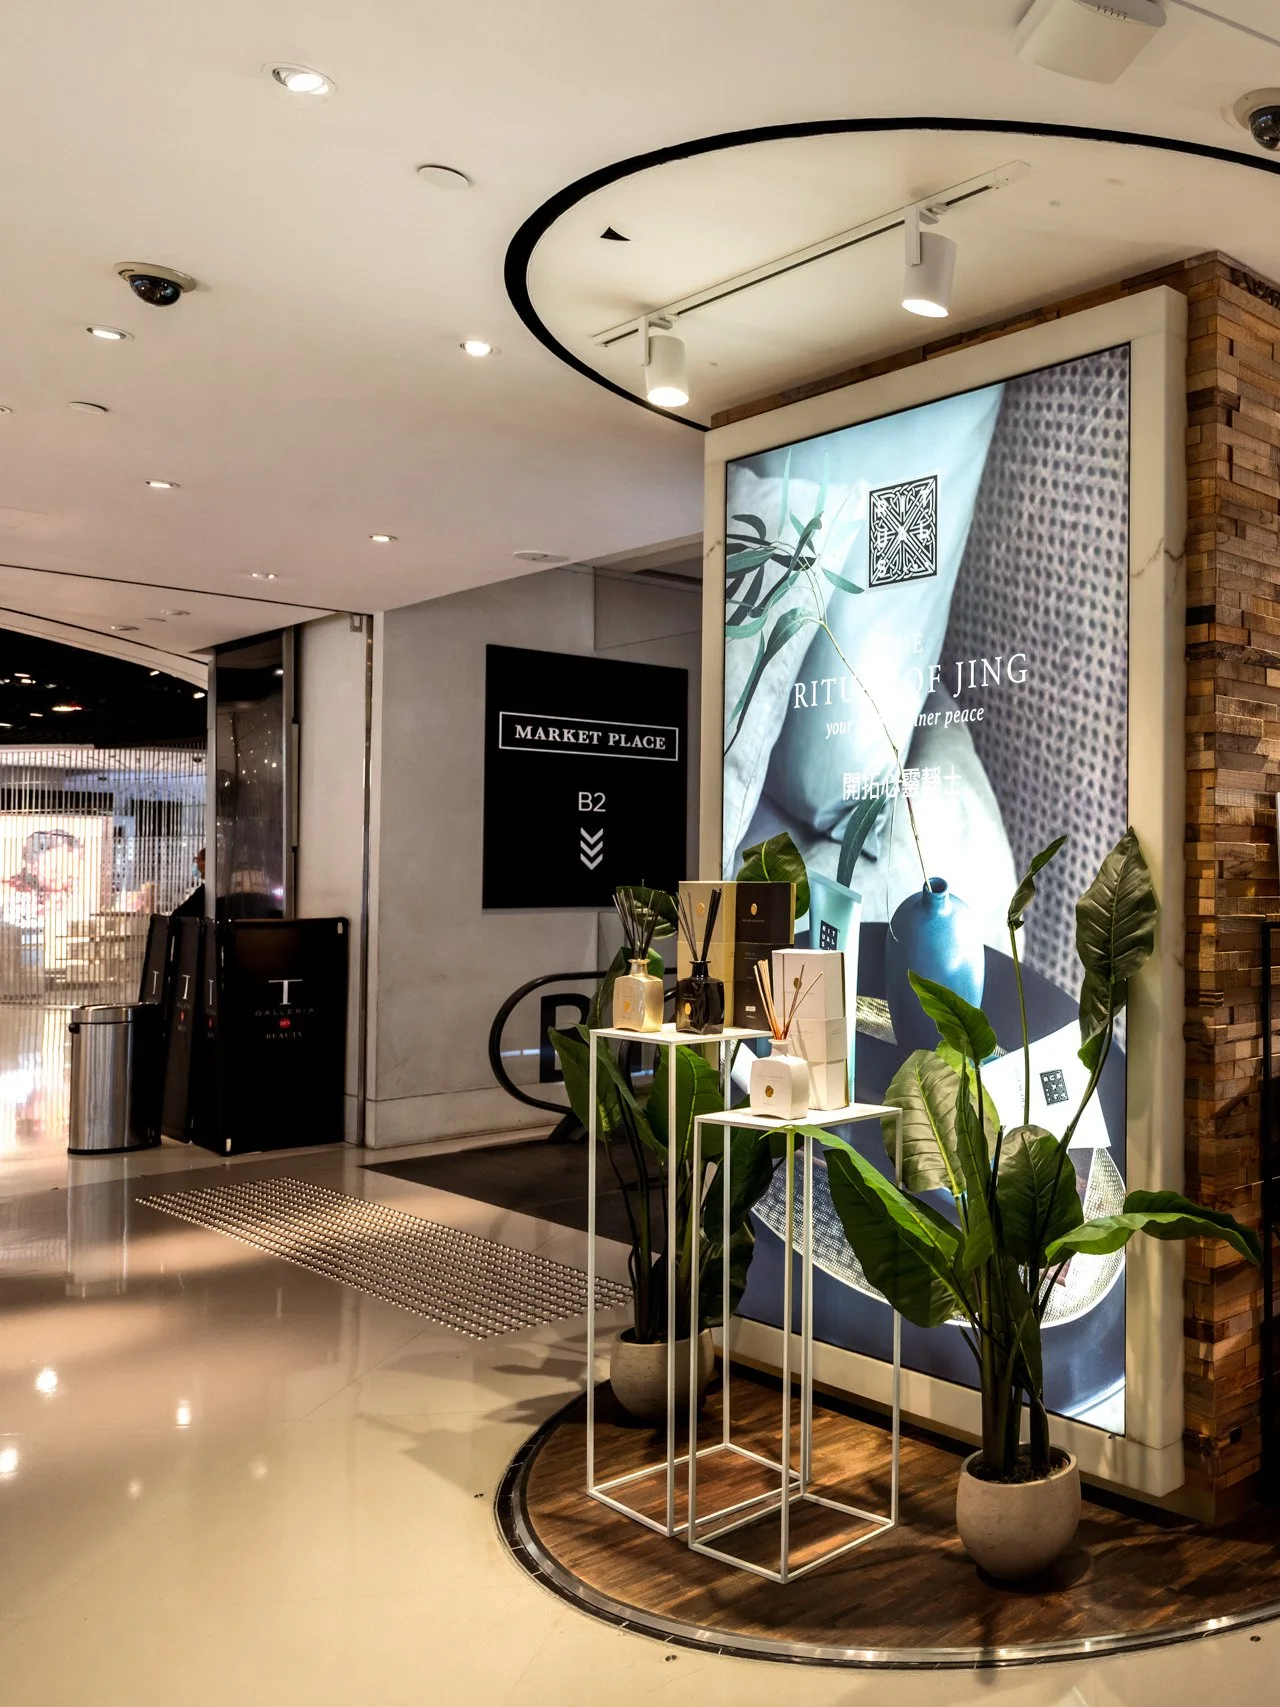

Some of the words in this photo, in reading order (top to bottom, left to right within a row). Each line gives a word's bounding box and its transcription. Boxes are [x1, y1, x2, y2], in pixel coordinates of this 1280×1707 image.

[953, 653, 1028, 698] JING
[825, 718, 854, 739] your
[944, 707, 985, 729] peace
[514, 724, 602, 744] MARKET
[608, 732, 667, 750] PLACE
[578, 791, 606, 812] B2
[268, 978, 304, 1005] T
[265, 1031, 303, 1040] BEAUTY
